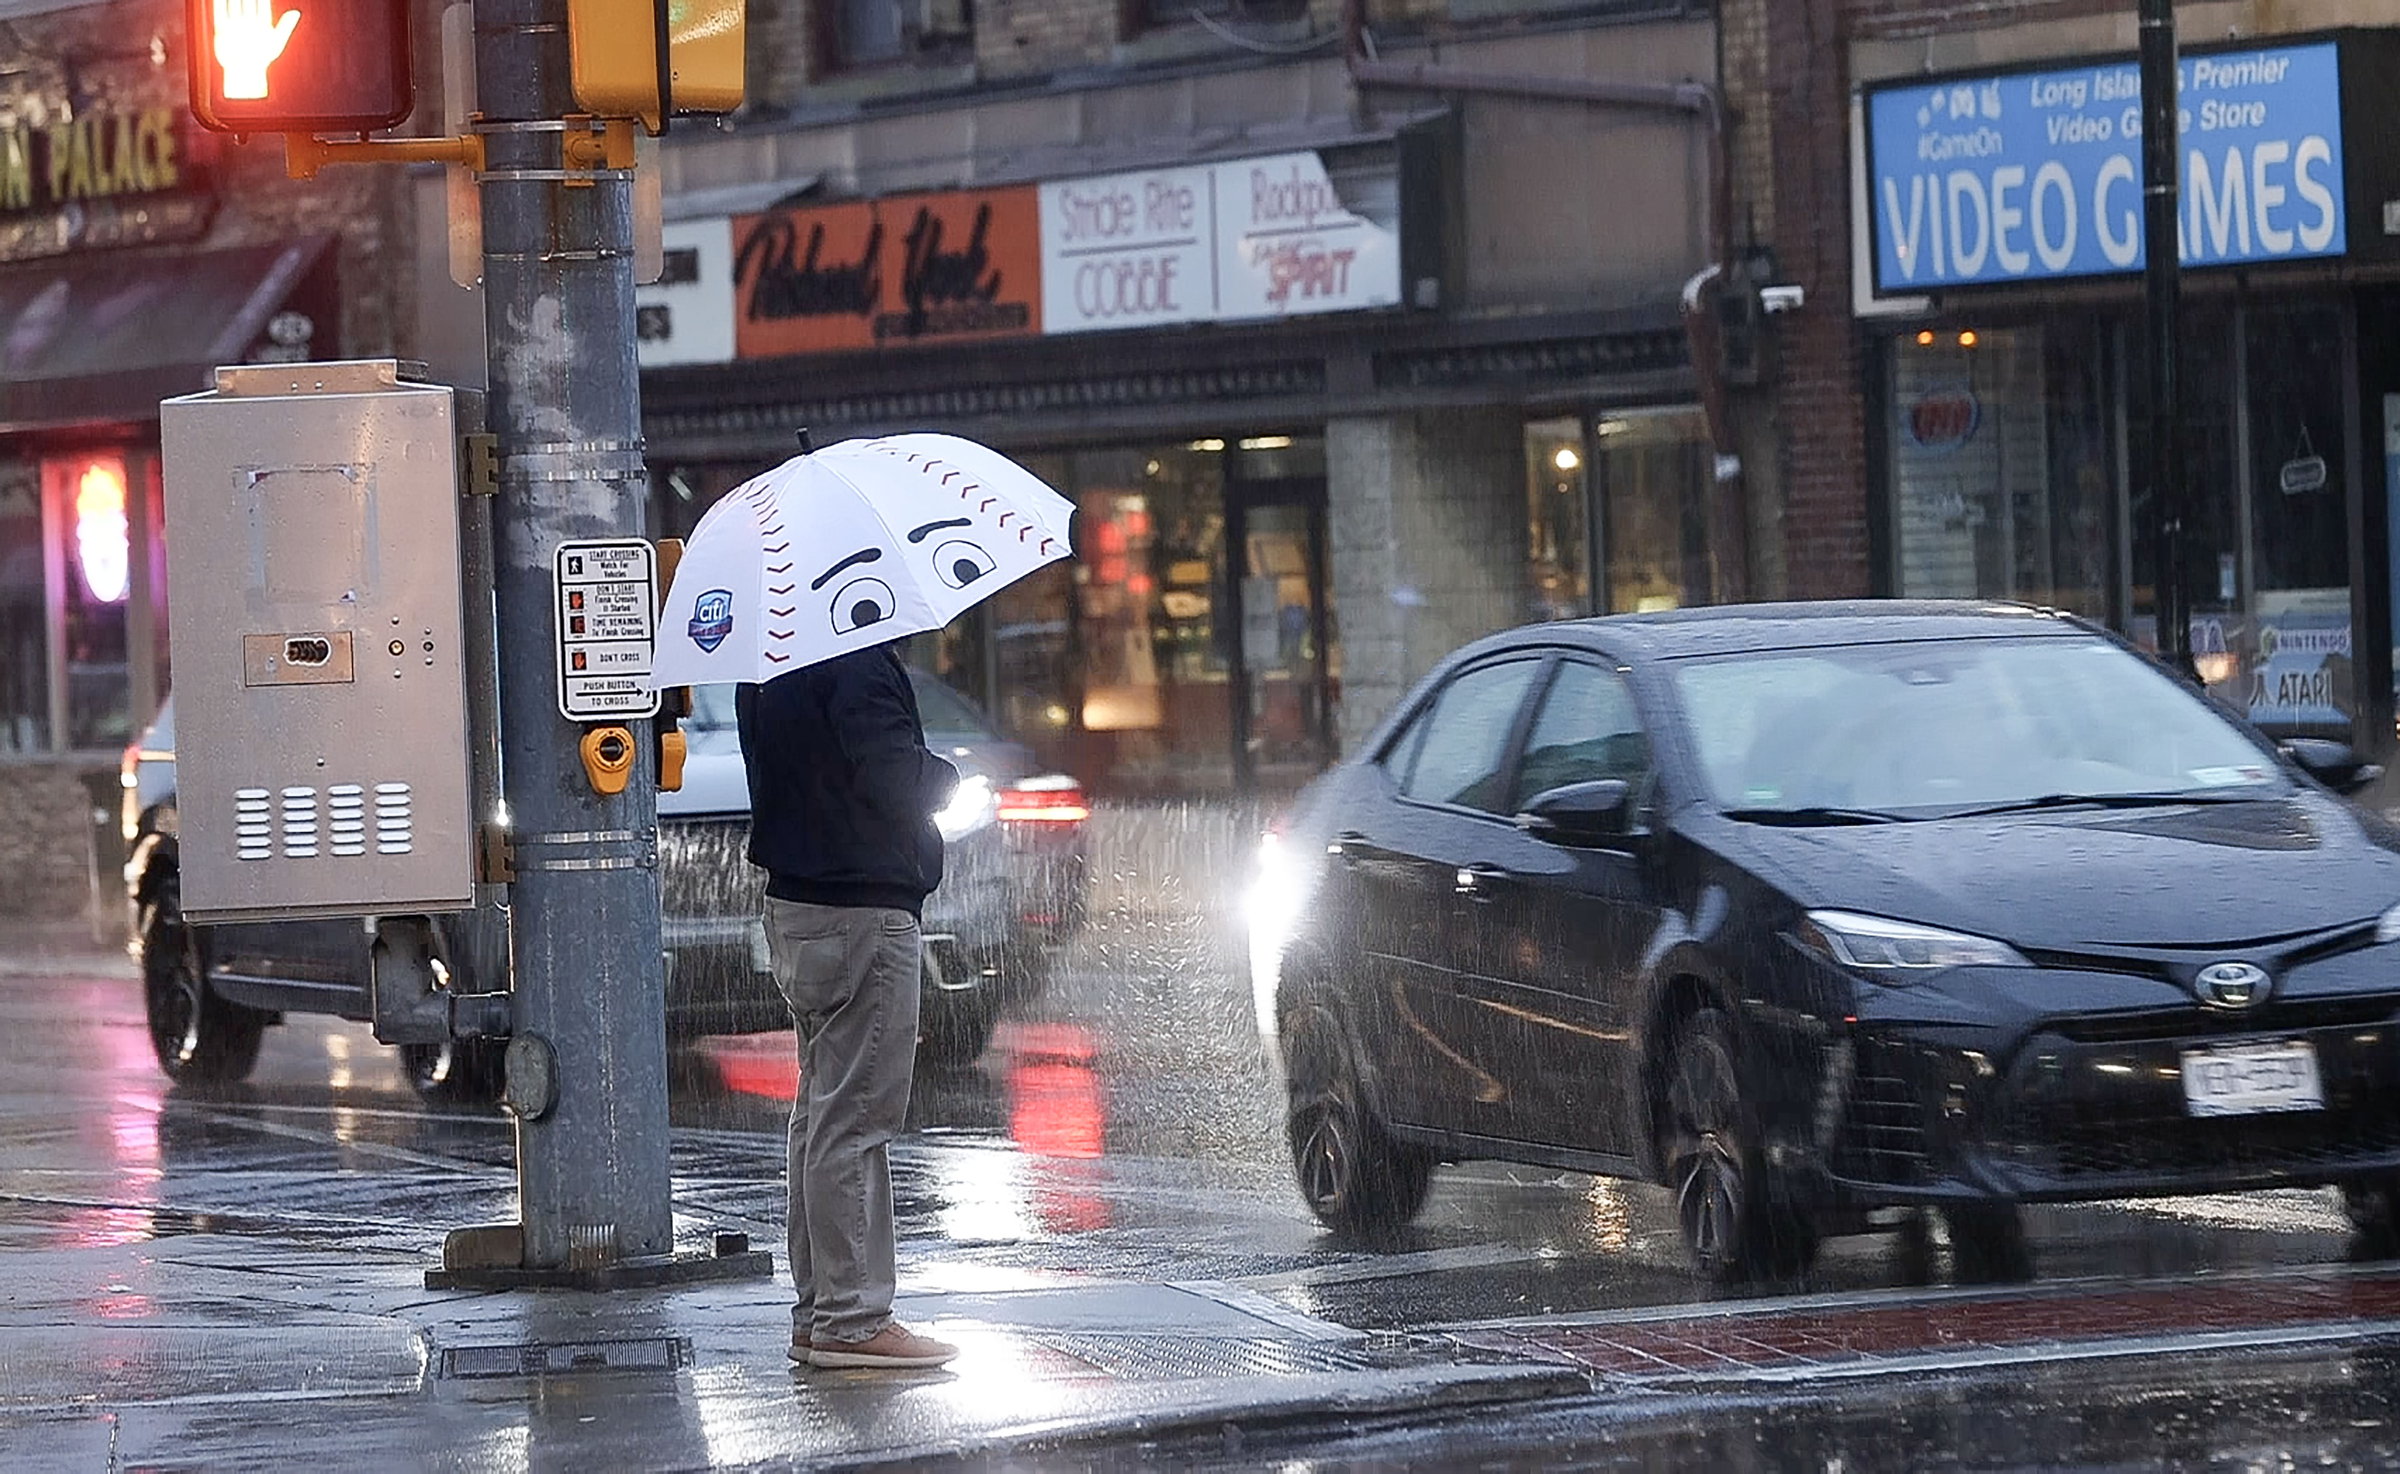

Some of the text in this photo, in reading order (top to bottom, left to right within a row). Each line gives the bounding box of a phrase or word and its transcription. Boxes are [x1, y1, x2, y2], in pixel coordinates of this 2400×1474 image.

[2030, 54, 2289, 109] Long Islas Premier
[2046, 99, 2266, 145] Video Ge Store
[51, 109, 177, 200] PALACE
[1884, 135, 2336, 280] VIDEO GMES
[700, 599, 725, 622] citi
[600, 653, 640, 662] DON'T CROSS
[584, 681, 636, 690] PUSH BUTTON
[592, 696, 630, 706] TO CROSS
[2278, 671, 2334, 708] ATARI
